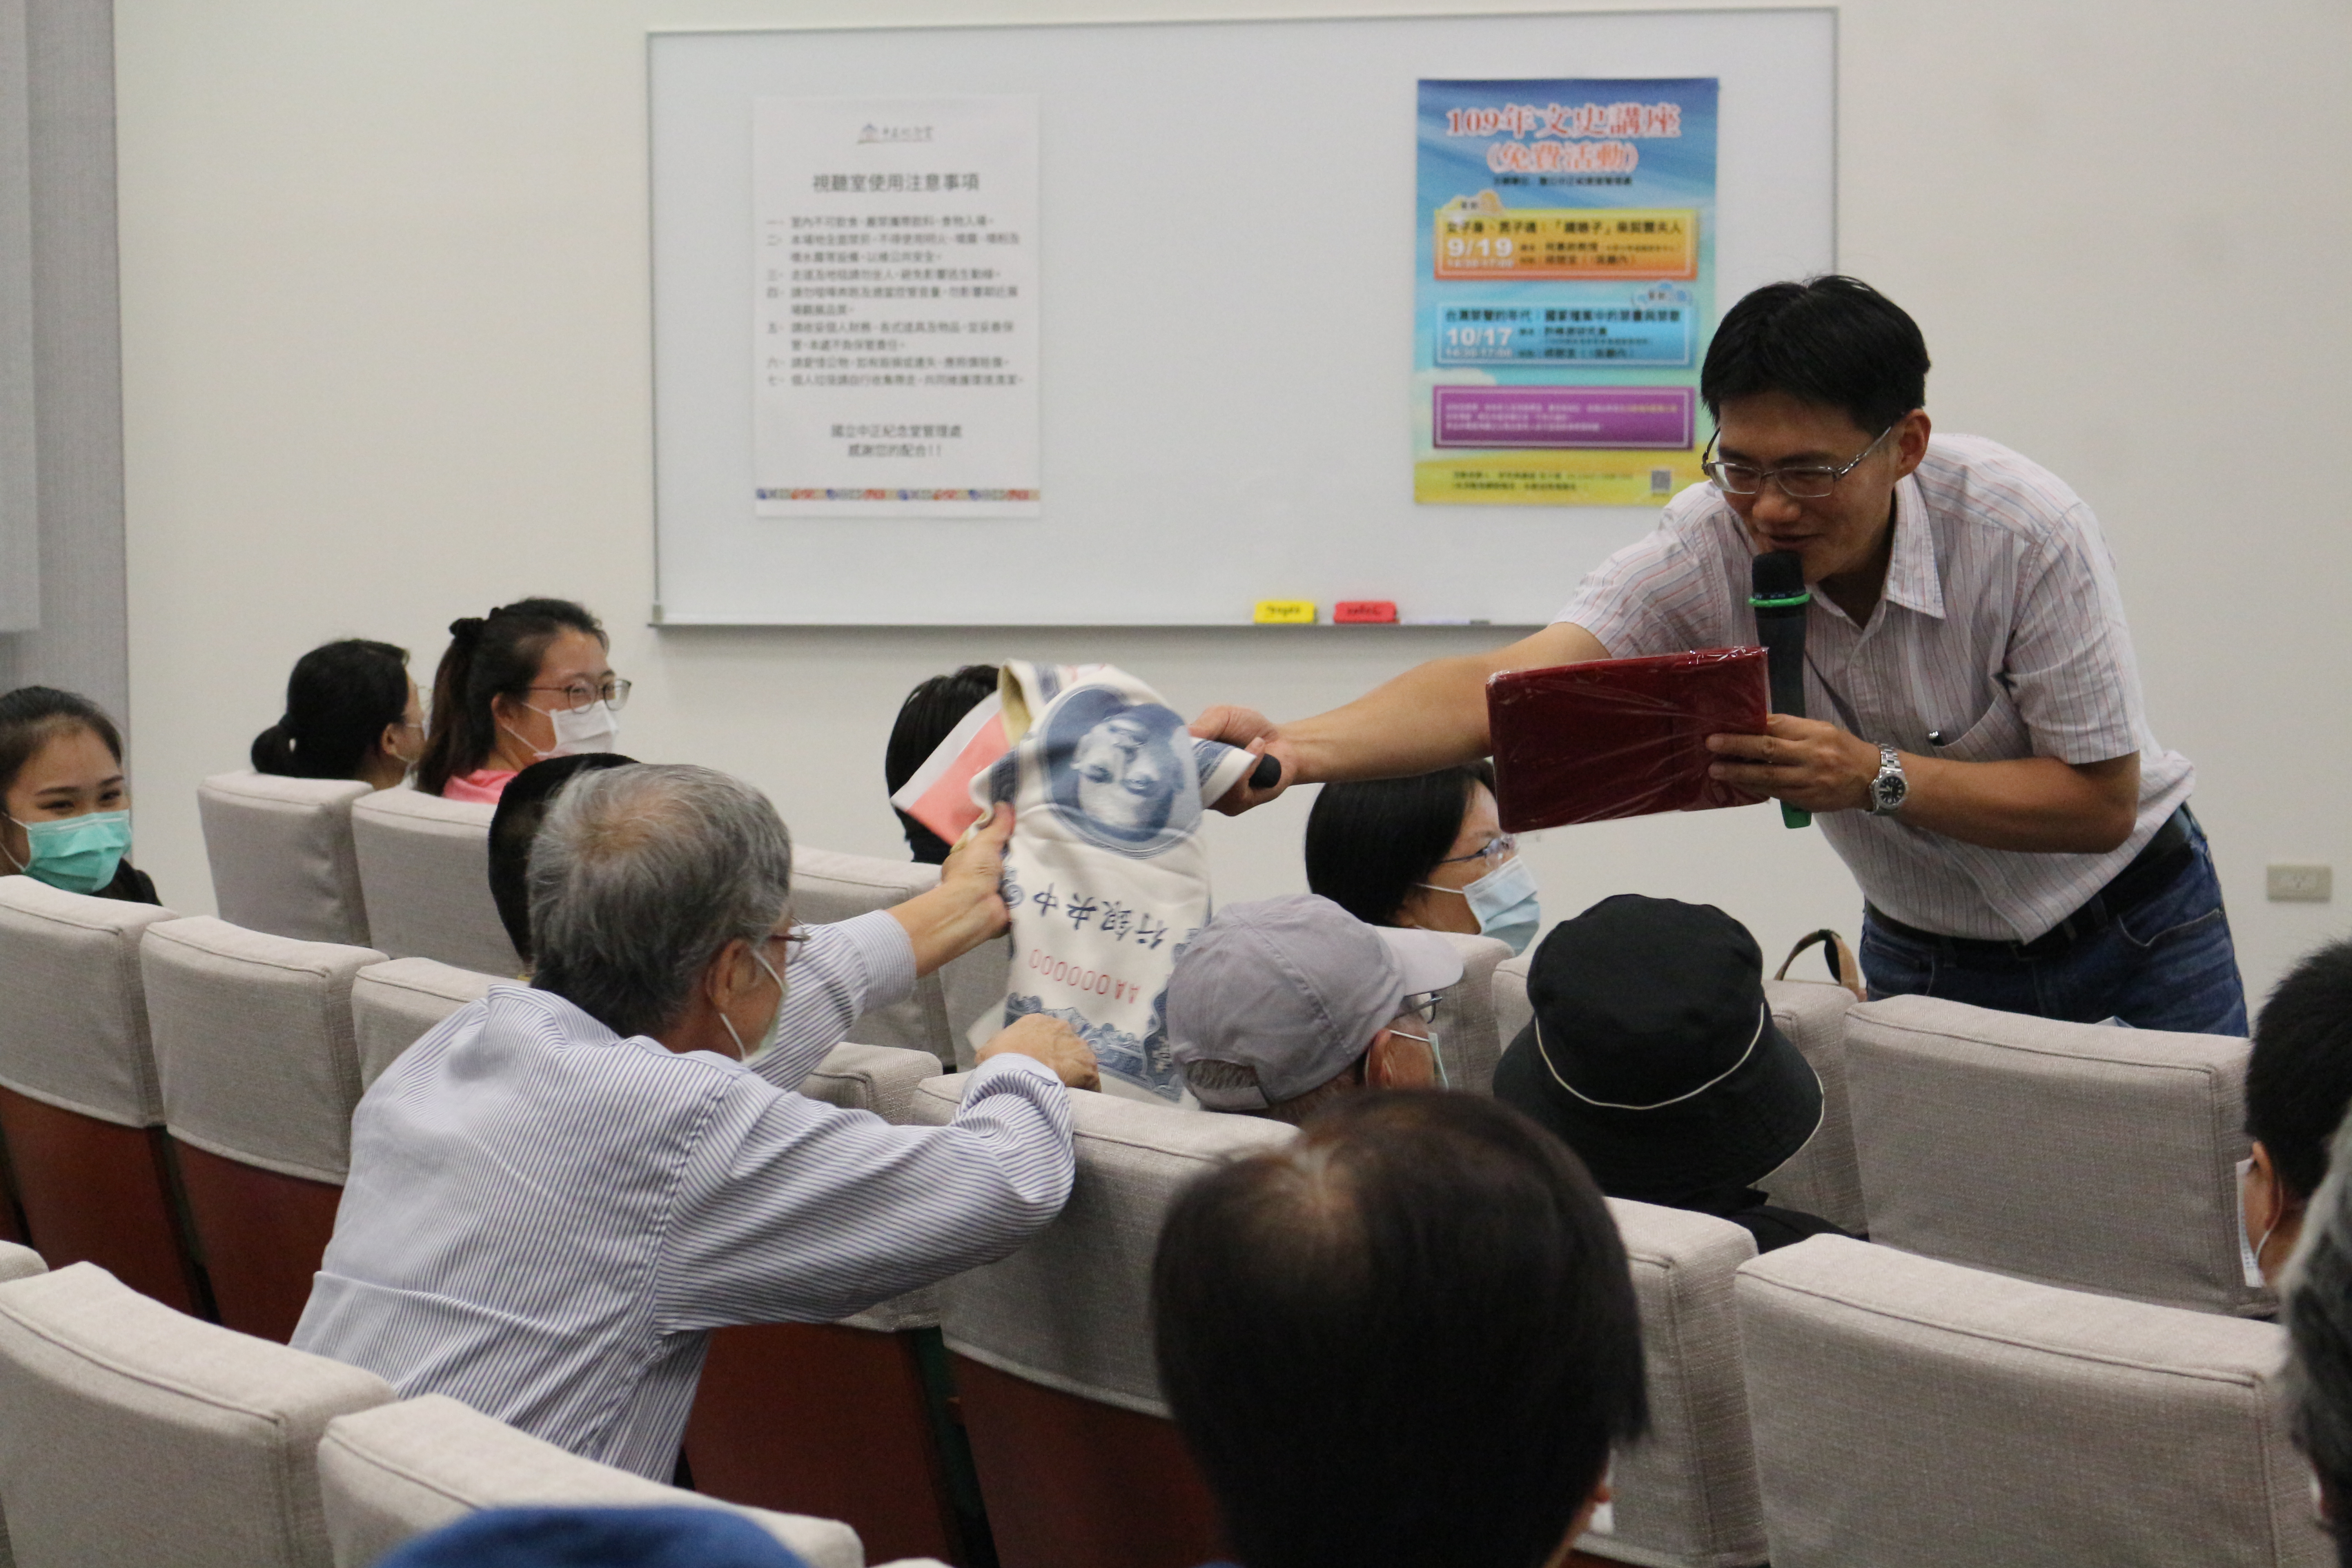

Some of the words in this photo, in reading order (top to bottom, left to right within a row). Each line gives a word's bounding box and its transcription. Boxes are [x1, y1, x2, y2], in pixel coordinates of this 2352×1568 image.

[1446, 103, 1681, 139] 109年文史講座
[813, 173, 979, 192] 視聽室使用注意事項
[1448, 238, 1513, 257] 9/19
[1446, 327, 1512, 346] 10/17
